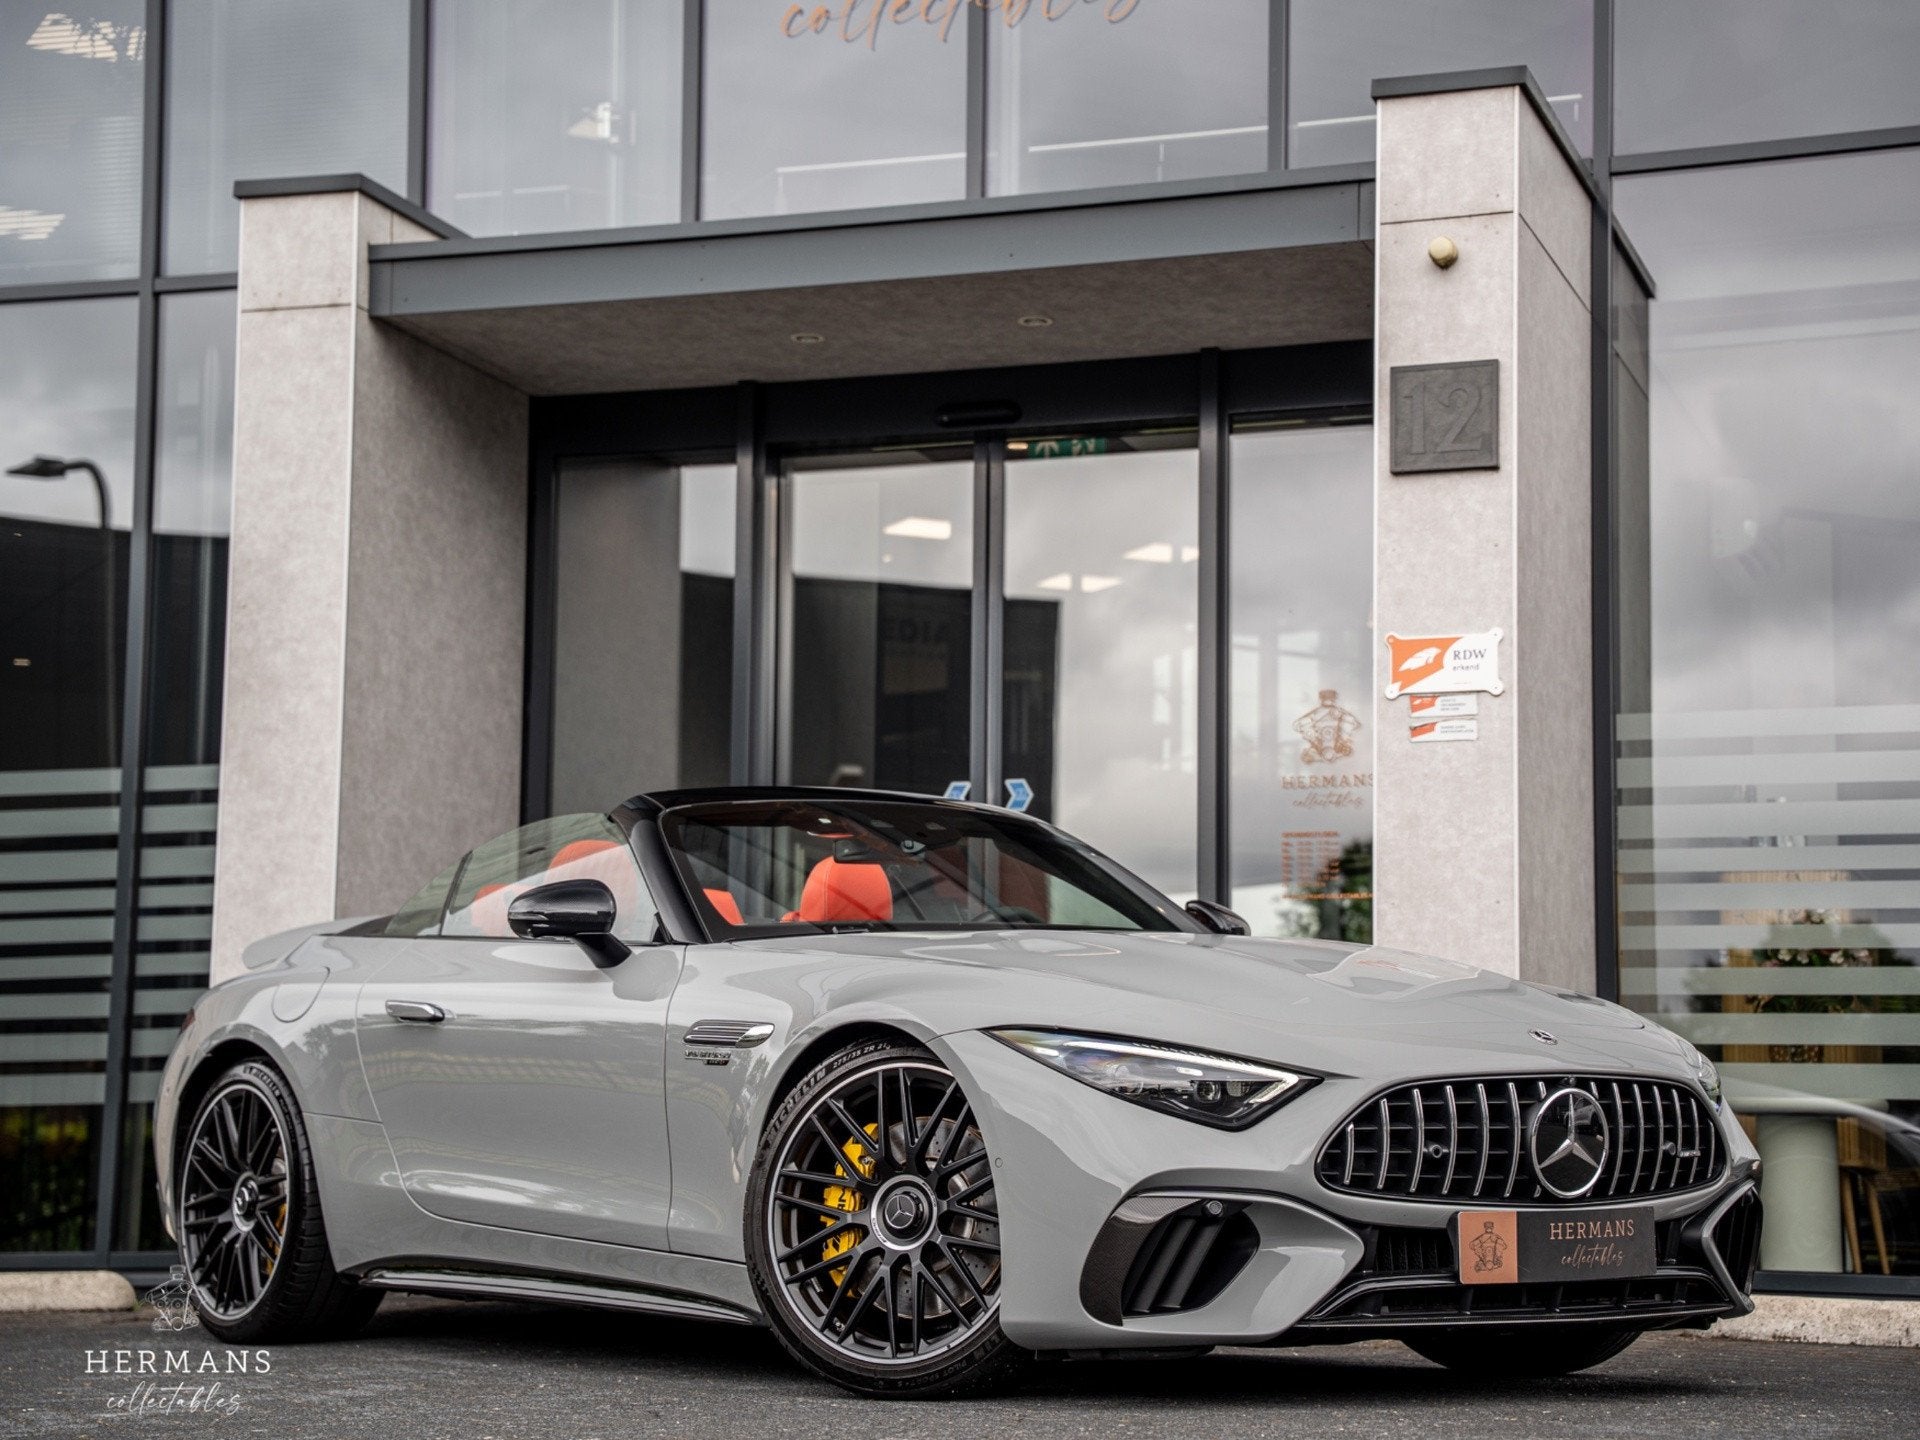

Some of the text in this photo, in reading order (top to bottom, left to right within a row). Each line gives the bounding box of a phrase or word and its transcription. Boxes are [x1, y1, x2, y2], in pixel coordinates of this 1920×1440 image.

[1401, 381, 1482, 456] 12
[1453, 648, 1487, 661] RDW
[1453, 663, 1479, 673] erkend
[1550, 1219, 1635, 1240] HERMANS
[1561, 1243, 1625, 1269] collectables
